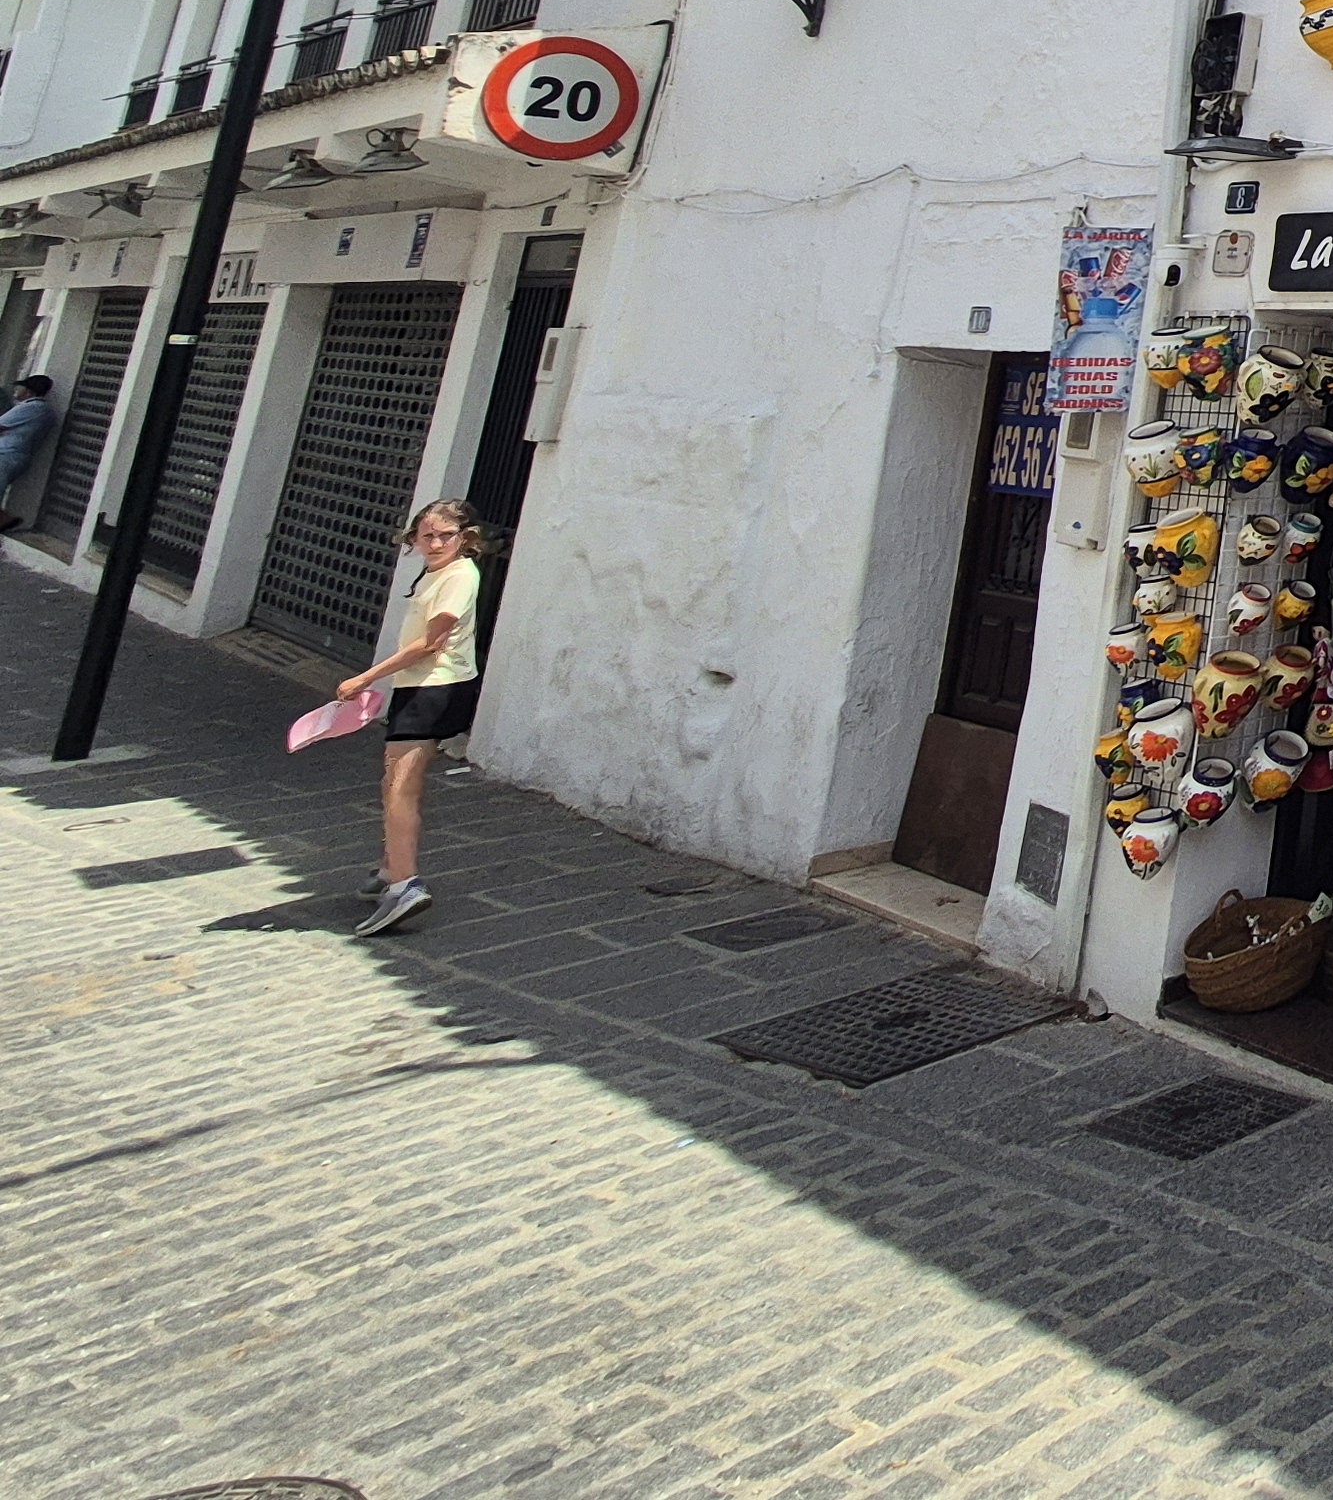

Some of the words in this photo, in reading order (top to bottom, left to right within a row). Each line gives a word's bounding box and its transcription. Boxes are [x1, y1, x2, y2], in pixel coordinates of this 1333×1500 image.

[524, 76, 601, 122] 20
[1236, 186, 1246, 209] 8
[1063, 231, 1085, 241] LA
[1087, 231, 1144, 242] JARITA
[1290, 228, 1333, 270] La
[1062, 371, 1119, 382] FRIAS
[1022, 371, 1047, 416] SE
[1065, 384, 1114, 395] COLD
[1053, 398, 1124, 409] DRINKS
[990, 424, 1021, 486] 952
[1021, 426, 1044, 489] 56
[1042, 427, 1058, 489] 2
